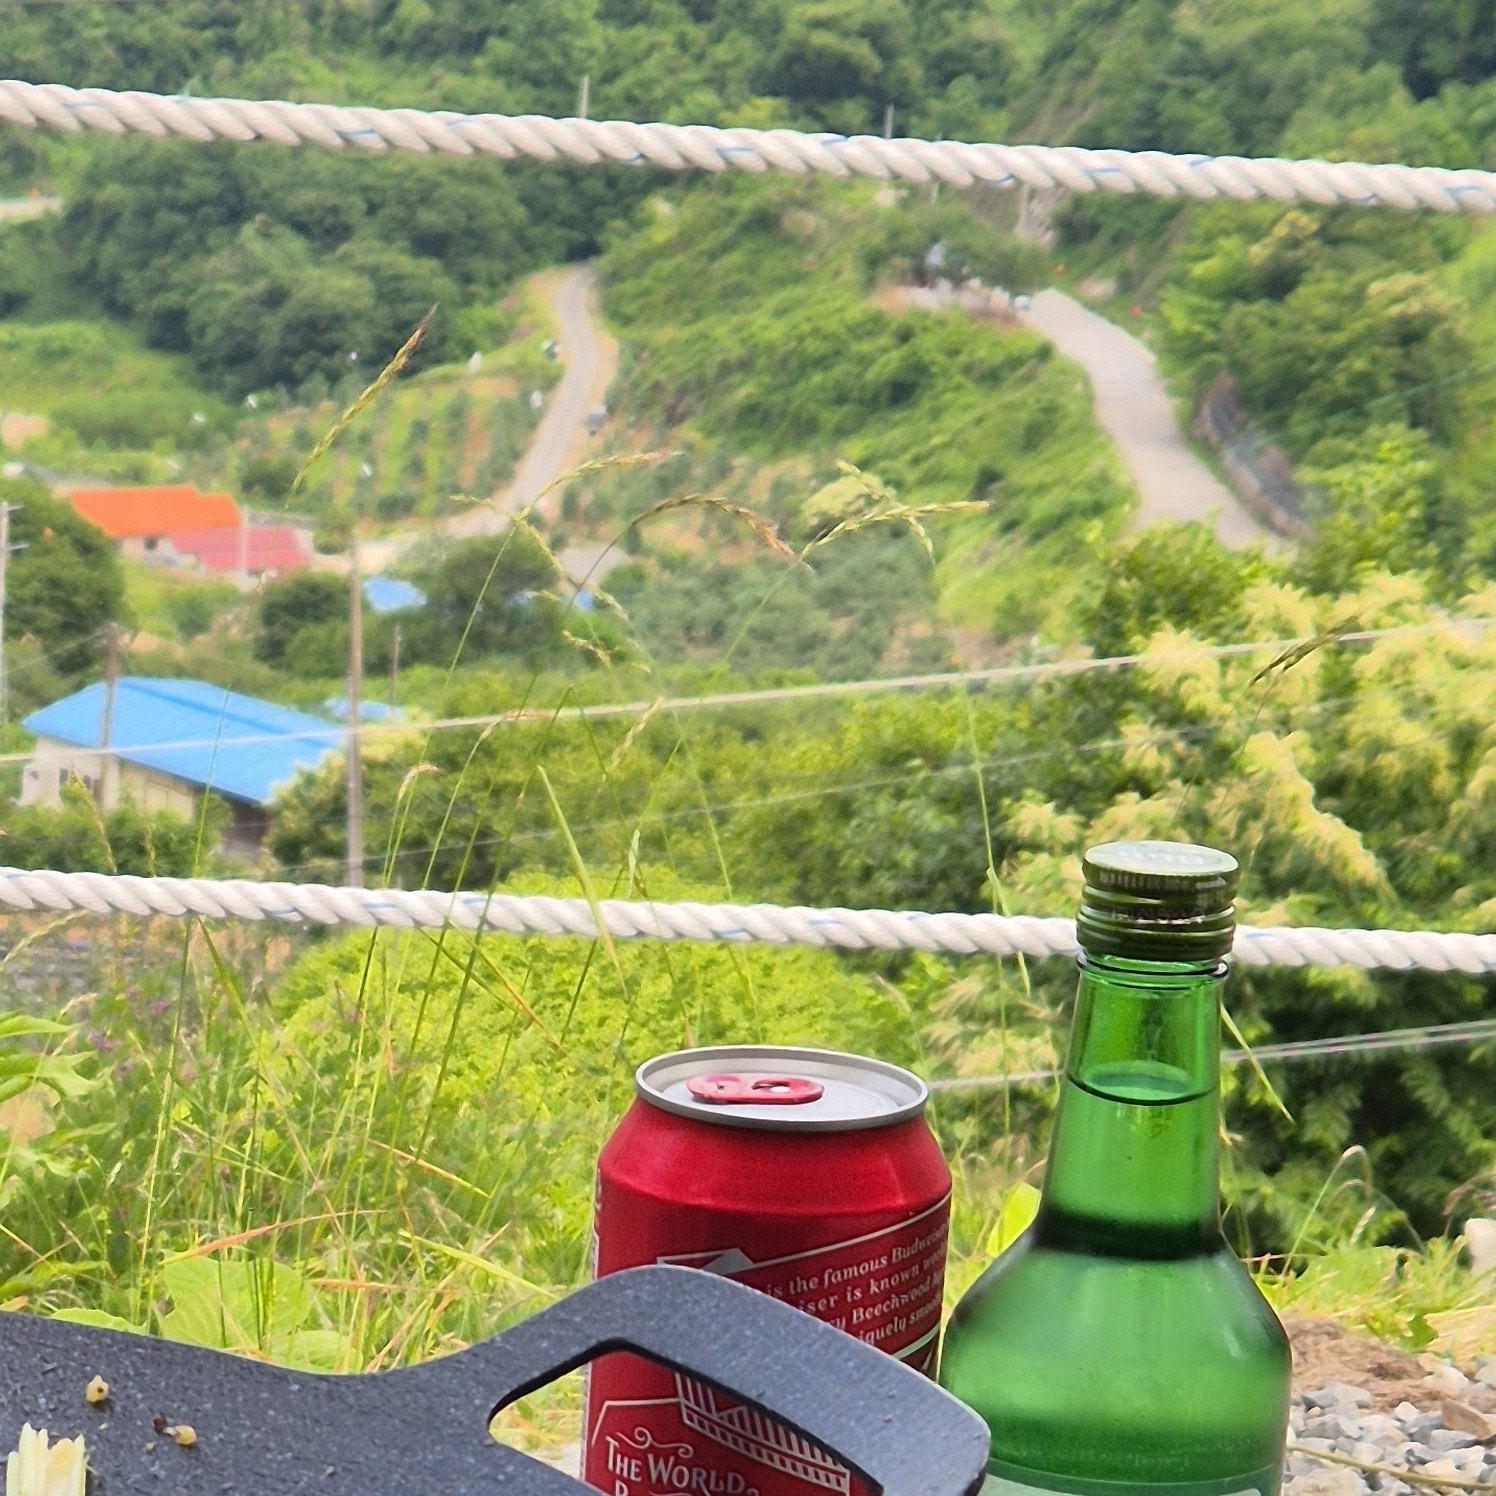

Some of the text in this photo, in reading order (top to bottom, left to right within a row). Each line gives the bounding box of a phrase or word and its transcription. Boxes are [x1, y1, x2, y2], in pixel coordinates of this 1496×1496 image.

[788, 1276, 819, 1294] the
[823, 1255, 887, 1288] famous
[846, 1286, 862, 1302] is
[869, 1264, 919, 1294] known
[852, 1276, 931, 1325] Beechwood
